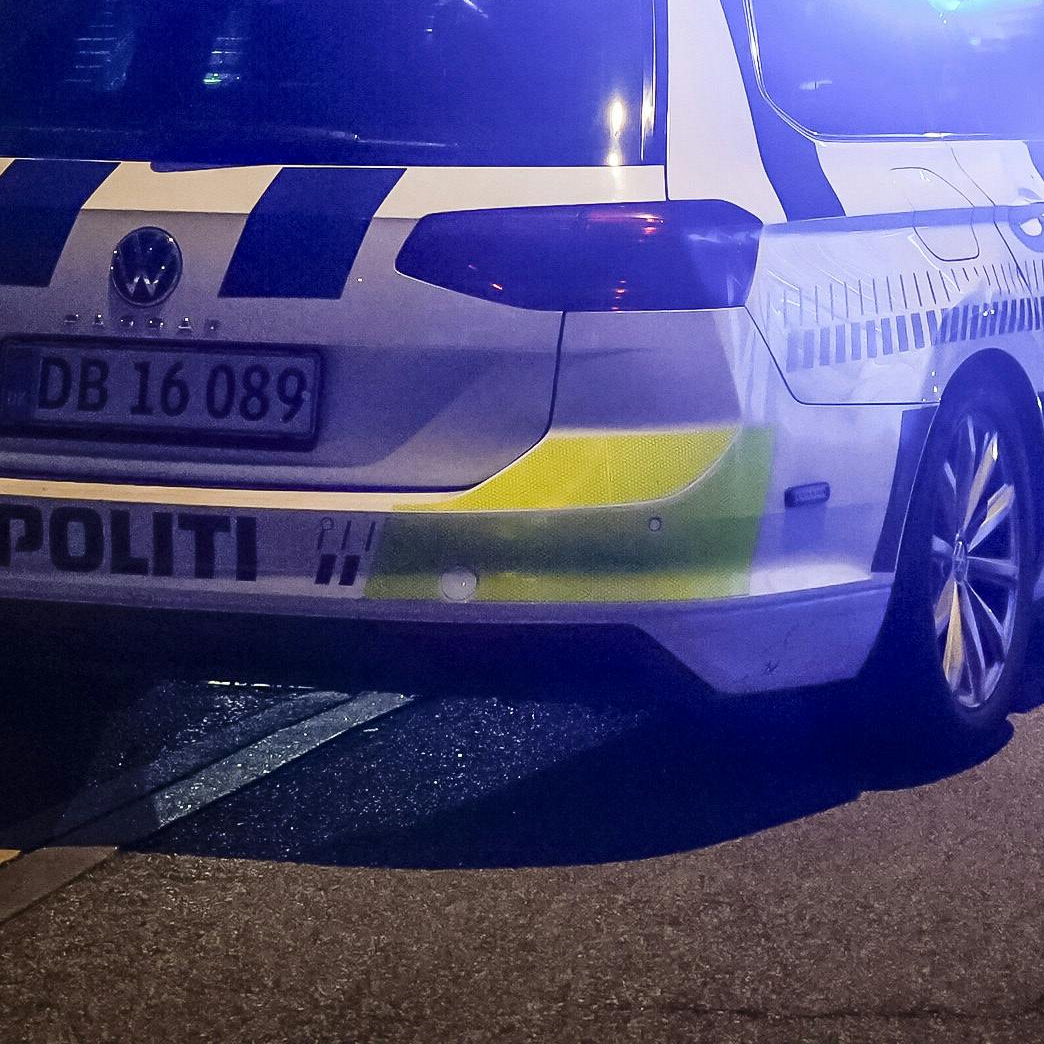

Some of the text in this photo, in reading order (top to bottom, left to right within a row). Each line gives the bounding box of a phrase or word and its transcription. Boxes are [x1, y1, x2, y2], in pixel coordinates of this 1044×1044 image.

[38, 356, 308, 424] DB 16 089
[0, 504, 257, 582] POLITI
